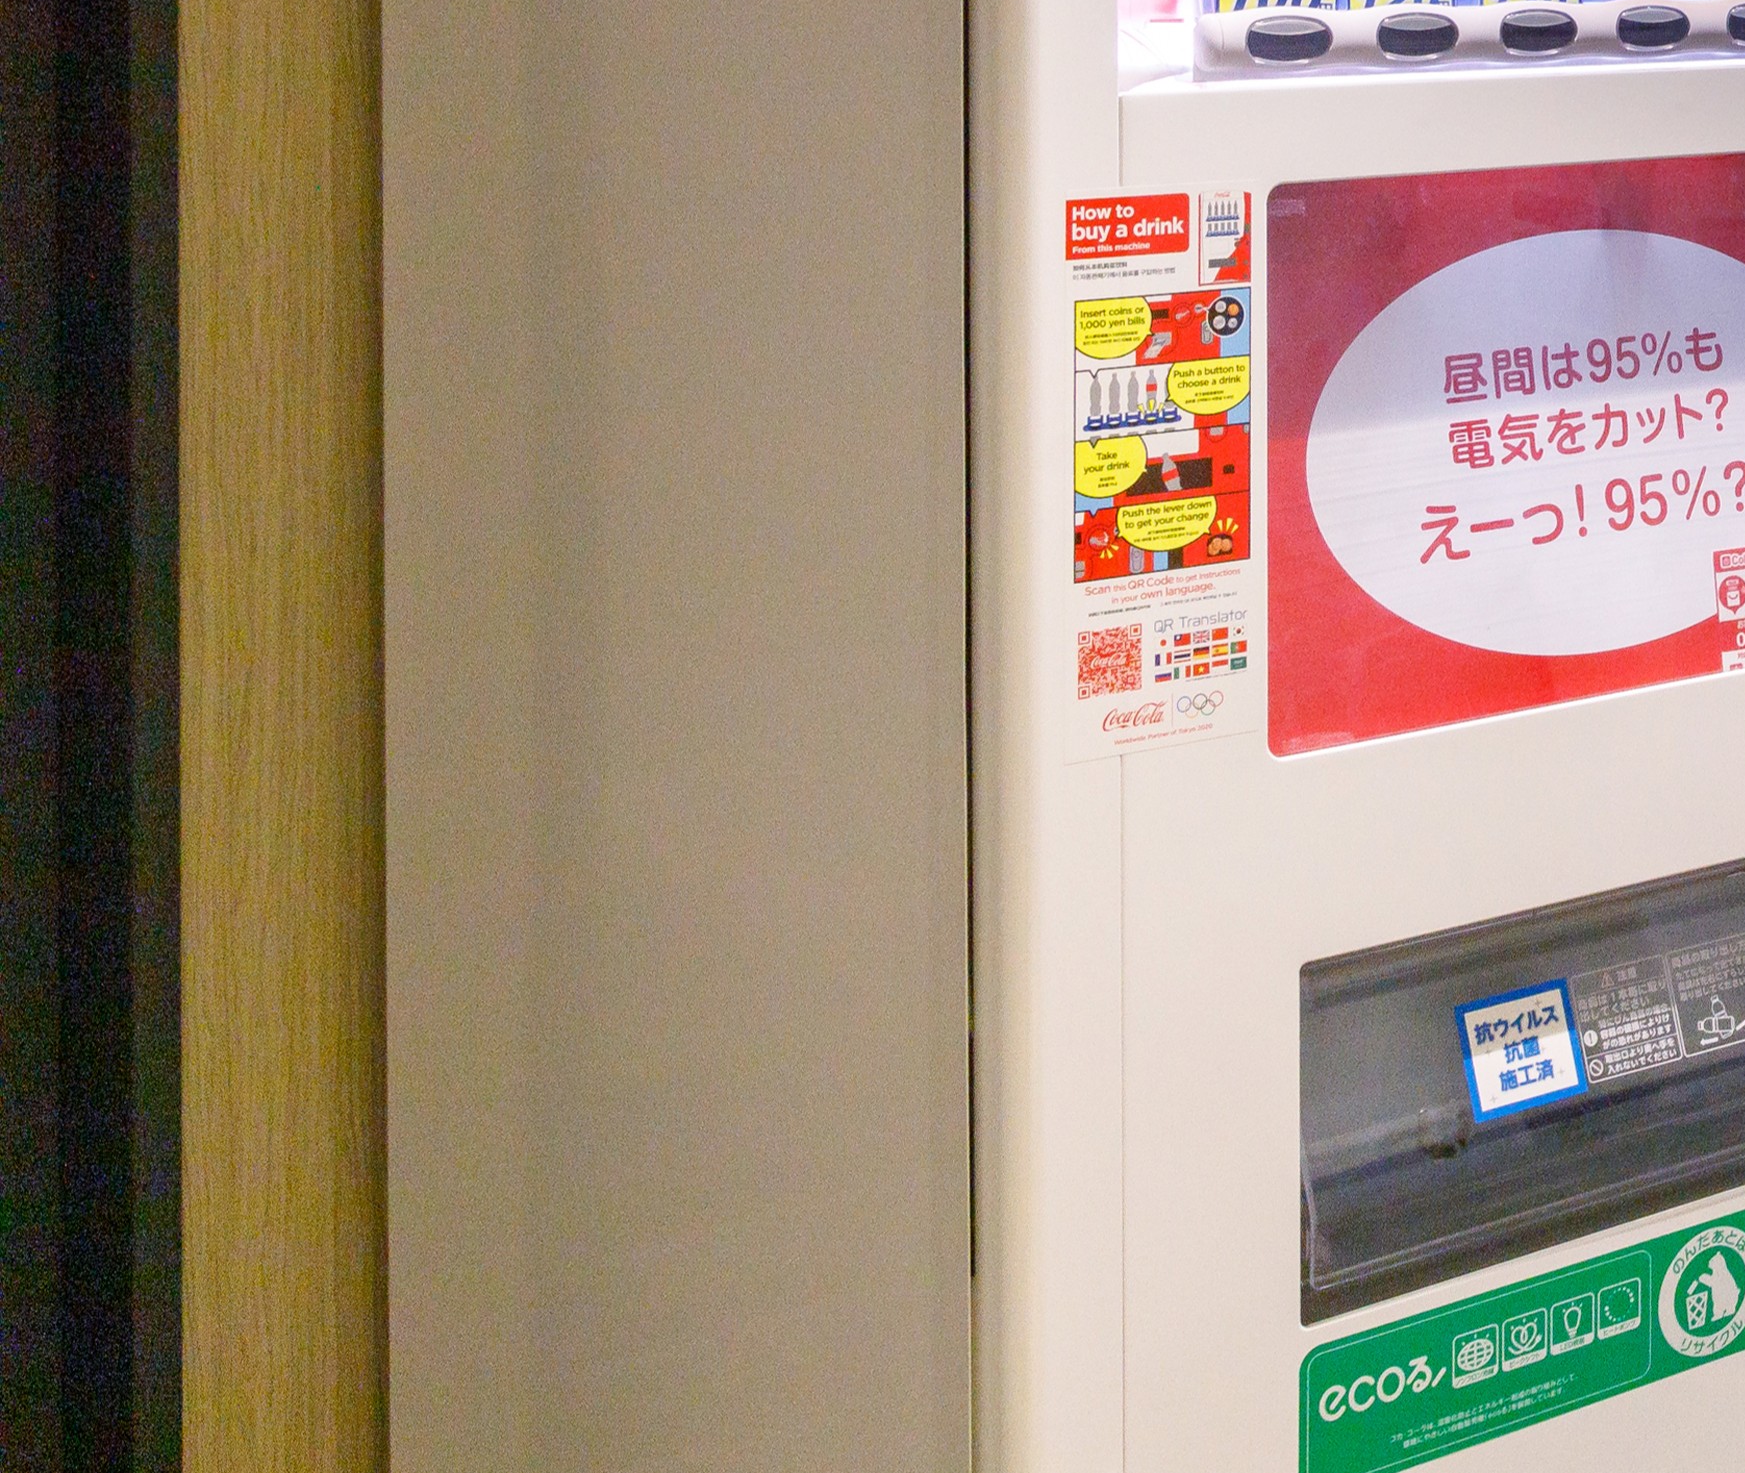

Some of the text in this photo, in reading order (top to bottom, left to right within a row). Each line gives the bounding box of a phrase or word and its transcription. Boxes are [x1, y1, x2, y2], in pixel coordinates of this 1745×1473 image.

[1072, 204, 1135, 221] How to
[1072, 217, 1184, 242] buy a drink
[1072, 246, 1096, 254] From
[1115, 242, 1150, 251] machine
[1080, 306, 1145, 319] Insert coins or
[1080, 316, 1145, 331] 1,000 yen bills
[1173, 369, 1195, 378] Push
[1204, 366, 1233, 376] button
[1443, 327, 1725, 403] 昼間は95%も
[1177, 379, 1209, 389] choose
[1219, 376, 1241, 385] drink
[1447, 388, 1729, 471] 電気をカット?
[1083, 461, 1130, 475] your drink
[1096, 452, 1118, 461] Take
[1122, 501, 1212, 518] Push the lever down
[1125, 512, 1209, 529] to get your change
[1084, 586, 1111, 597] Scan
[1128, 580, 1145, 591] QR
[1147, 576, 1175, 587] Code
[1185, 574, 1197, 584] get
[1198, 568, 1241, 580] instructions
[1111, 582, 1216, 605] in your own language.
[1153, 610, 1247, 633] QR Translator
[1102, 700, 1168, 732] Coca-Cola
[1474, 1006, 1559, 1045] 抗ウイルス
[1504, 1036, 1541, 1063] 抗菌
[1499, 1059, 1554, 1092] 施工済
[1680, 1317, 1745, 1357] リサイクル
